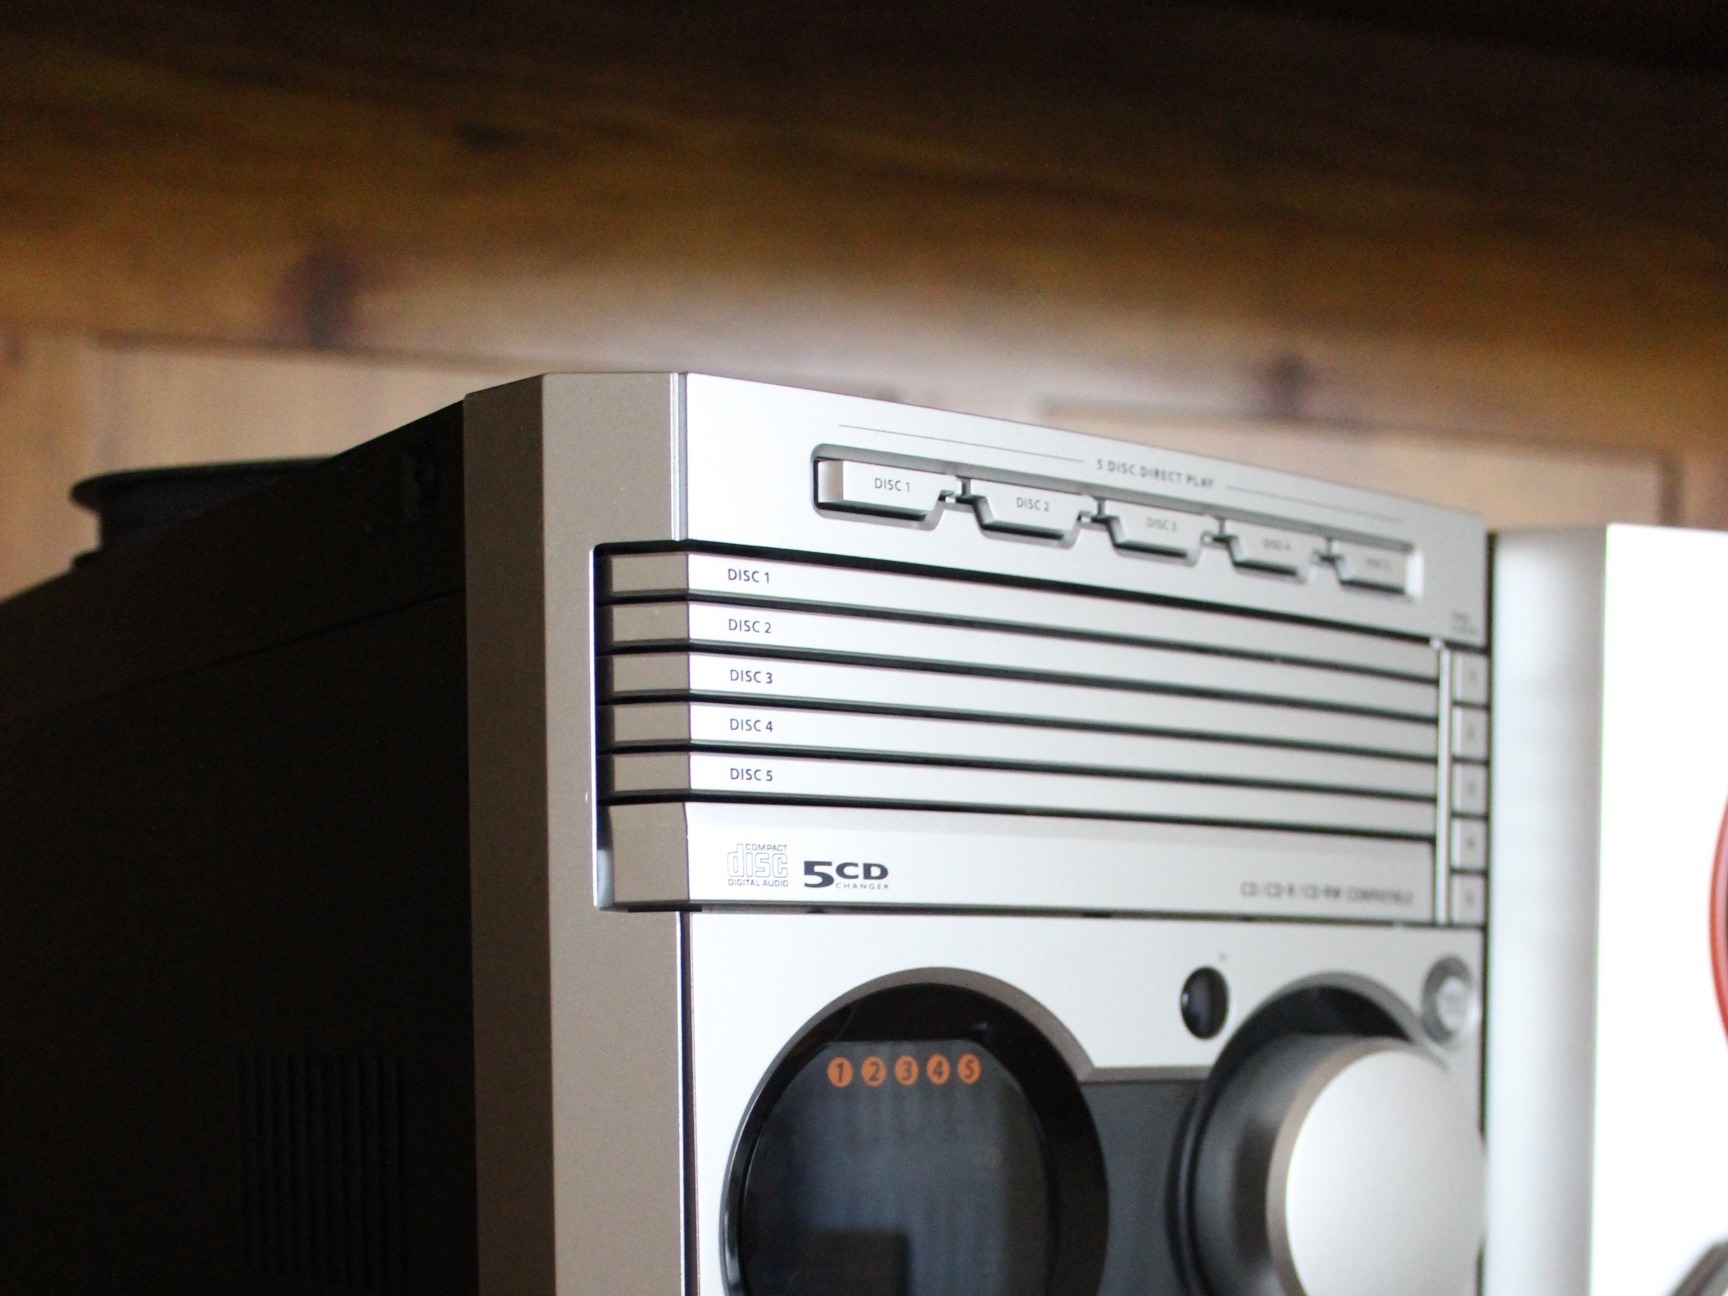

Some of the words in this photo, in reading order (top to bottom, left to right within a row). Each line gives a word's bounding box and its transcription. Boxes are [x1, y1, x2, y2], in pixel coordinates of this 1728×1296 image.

[1107, 460, 1135, 475] DISC
[1140, 465, 1181, 483] DIRECT
[874, 477, 902, 492] DISC
[906, 481, 911, 492] 1
[1016, 497, 1041, 511] DISC
[1043, 501, 1050, 512] 2
[727, 568, 761, 583] DISC
[764, 571, 771, 584] 1
[728, 618, 761, 633] DISC
[764, 622, 772, 634] 2
[729, 669, 763, 684] DISC
[765, 672, 773, 685] 3
[729, 718, 762, 733] DISC
[765, 720, 773, 733] 4
[729, 767, 763, 782] DISC
[765, 769, 773, 782] 5
[745, 843, 788, 852] COMPACT
[728, 878, 760, 887] DIGITAL
[762, 879, 789, 887] AUDIO
[835, 882, 889, 890] CHANGER
